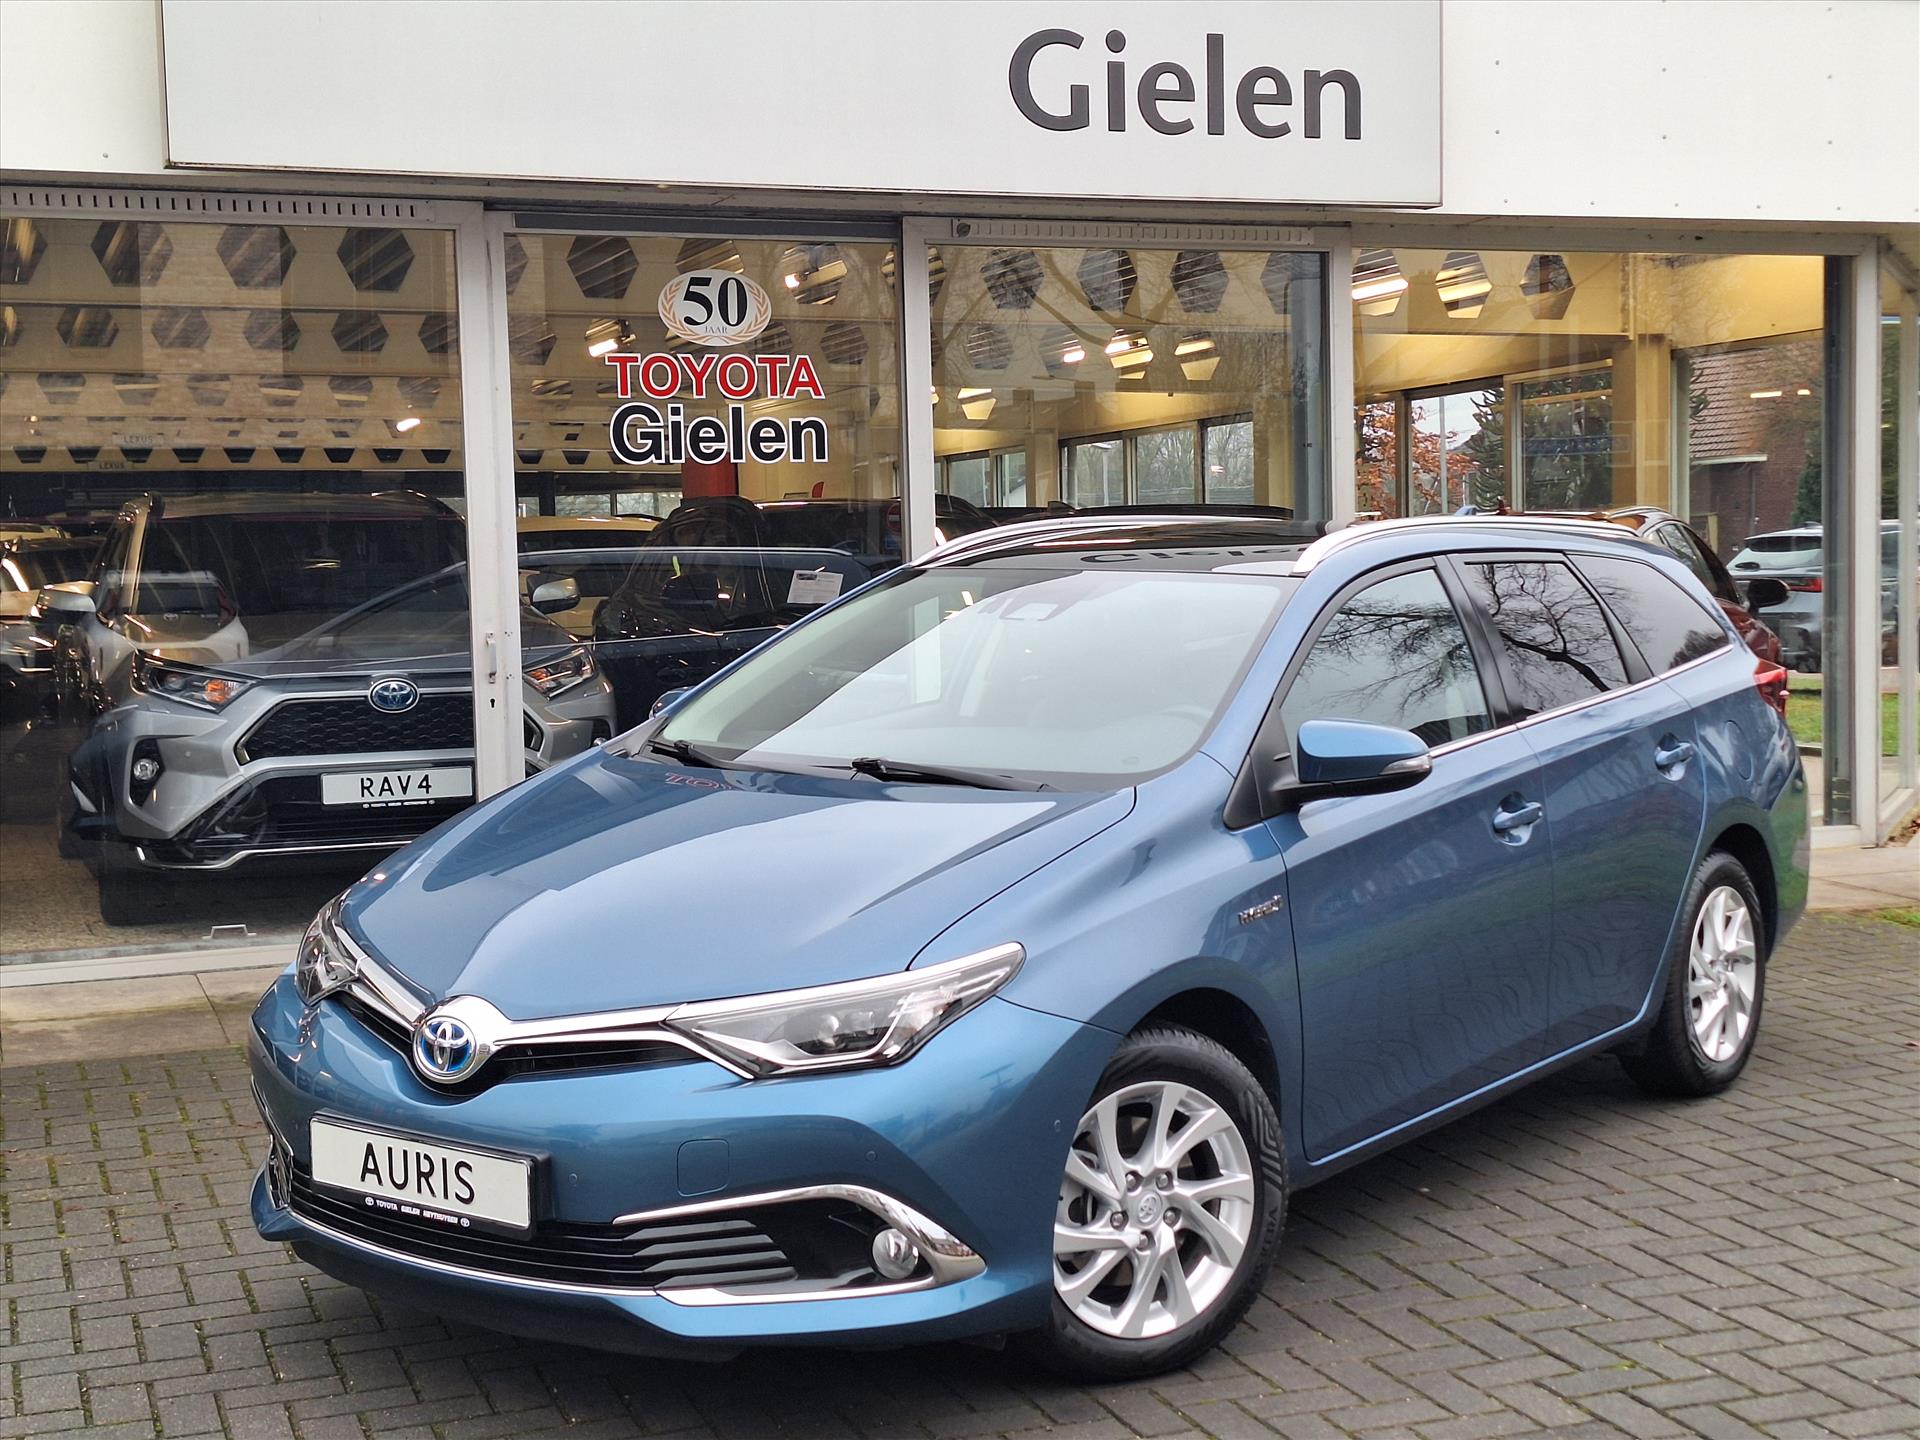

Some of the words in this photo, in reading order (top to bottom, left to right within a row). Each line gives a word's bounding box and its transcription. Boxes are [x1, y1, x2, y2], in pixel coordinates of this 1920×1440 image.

[1008, 28, 1362, 141] Gielen
[683, 276, 748, 327] 50
[704, 326, 728, 334] JAAR
[605, 353, 825, 399] TOYOTA
[610, 403, 829, 464] Gielen
[360, 774, 430, 798] RAV4
[360, 1142, 475, 1205] AURIS
[376, 1199, 398, 1210] TOYOTA
